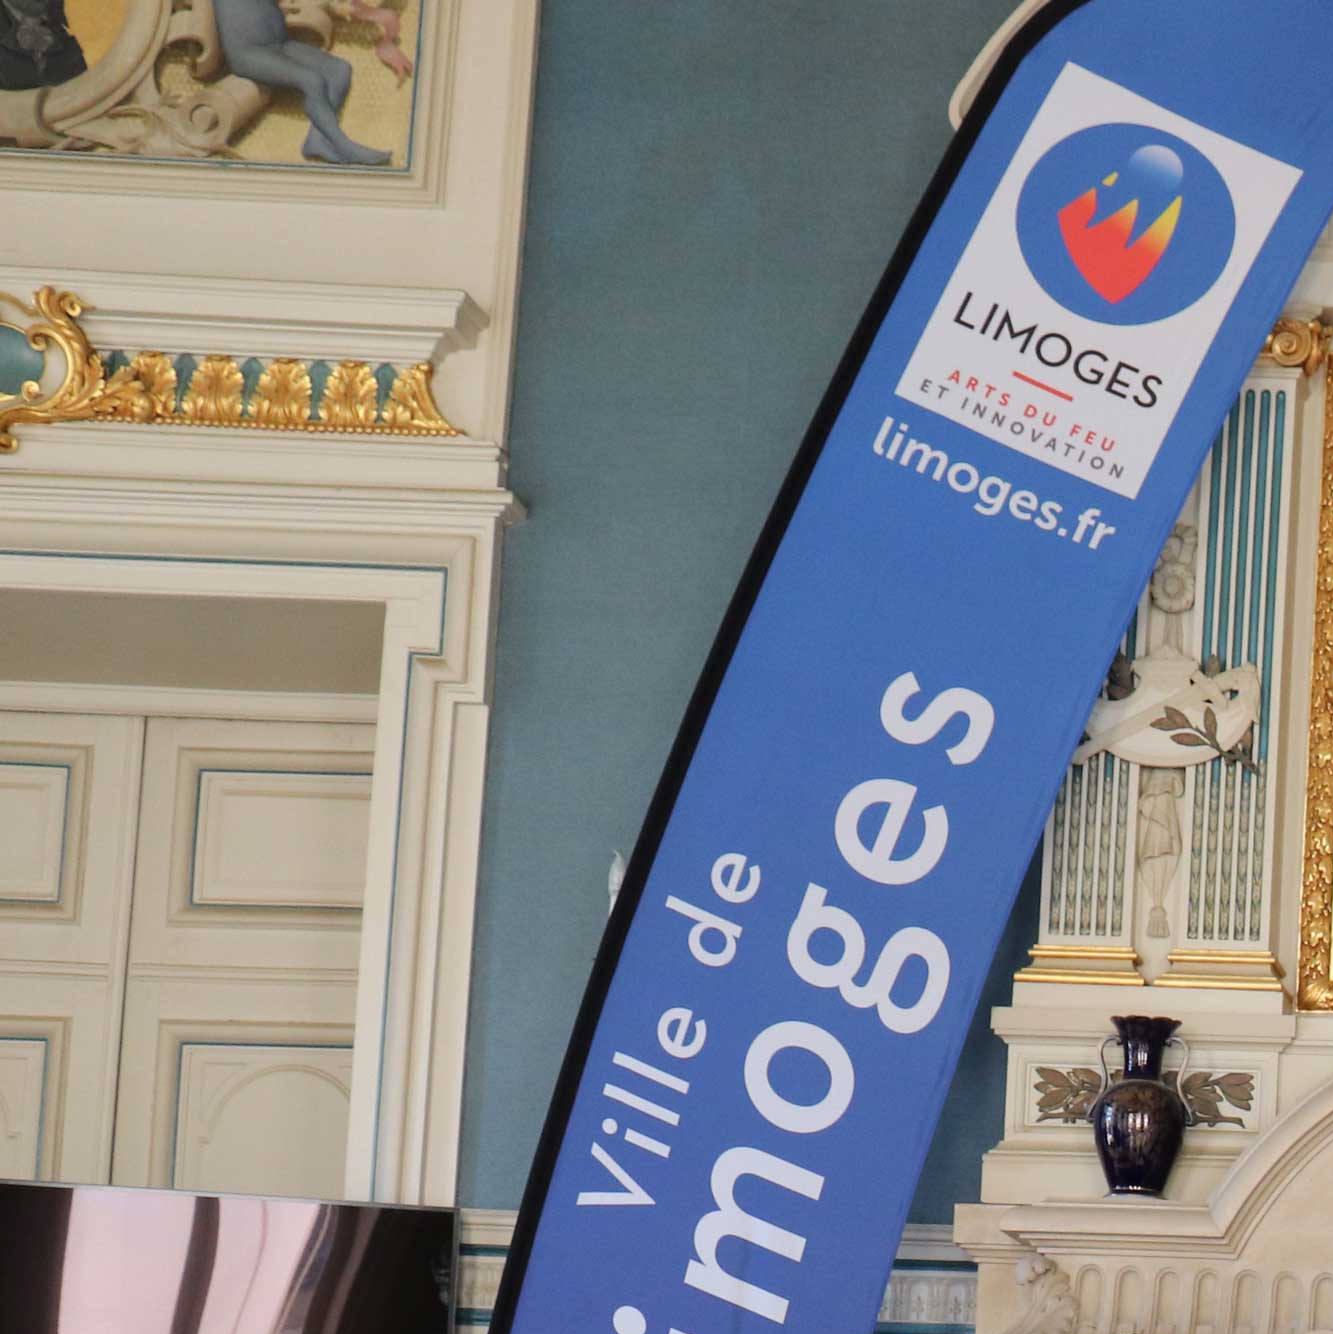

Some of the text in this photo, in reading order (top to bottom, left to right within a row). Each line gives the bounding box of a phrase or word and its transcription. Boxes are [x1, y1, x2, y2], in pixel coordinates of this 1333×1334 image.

[953, 291, 1163, 408] LIMOGES
[920, 378, 1125, 479] ET INNOVATION
[948, 370, 1115, 452] ARTS DU FEU
[872, 416, 1117, 550] limoges.fr
[576, 851, 762, 1207] Ville de
